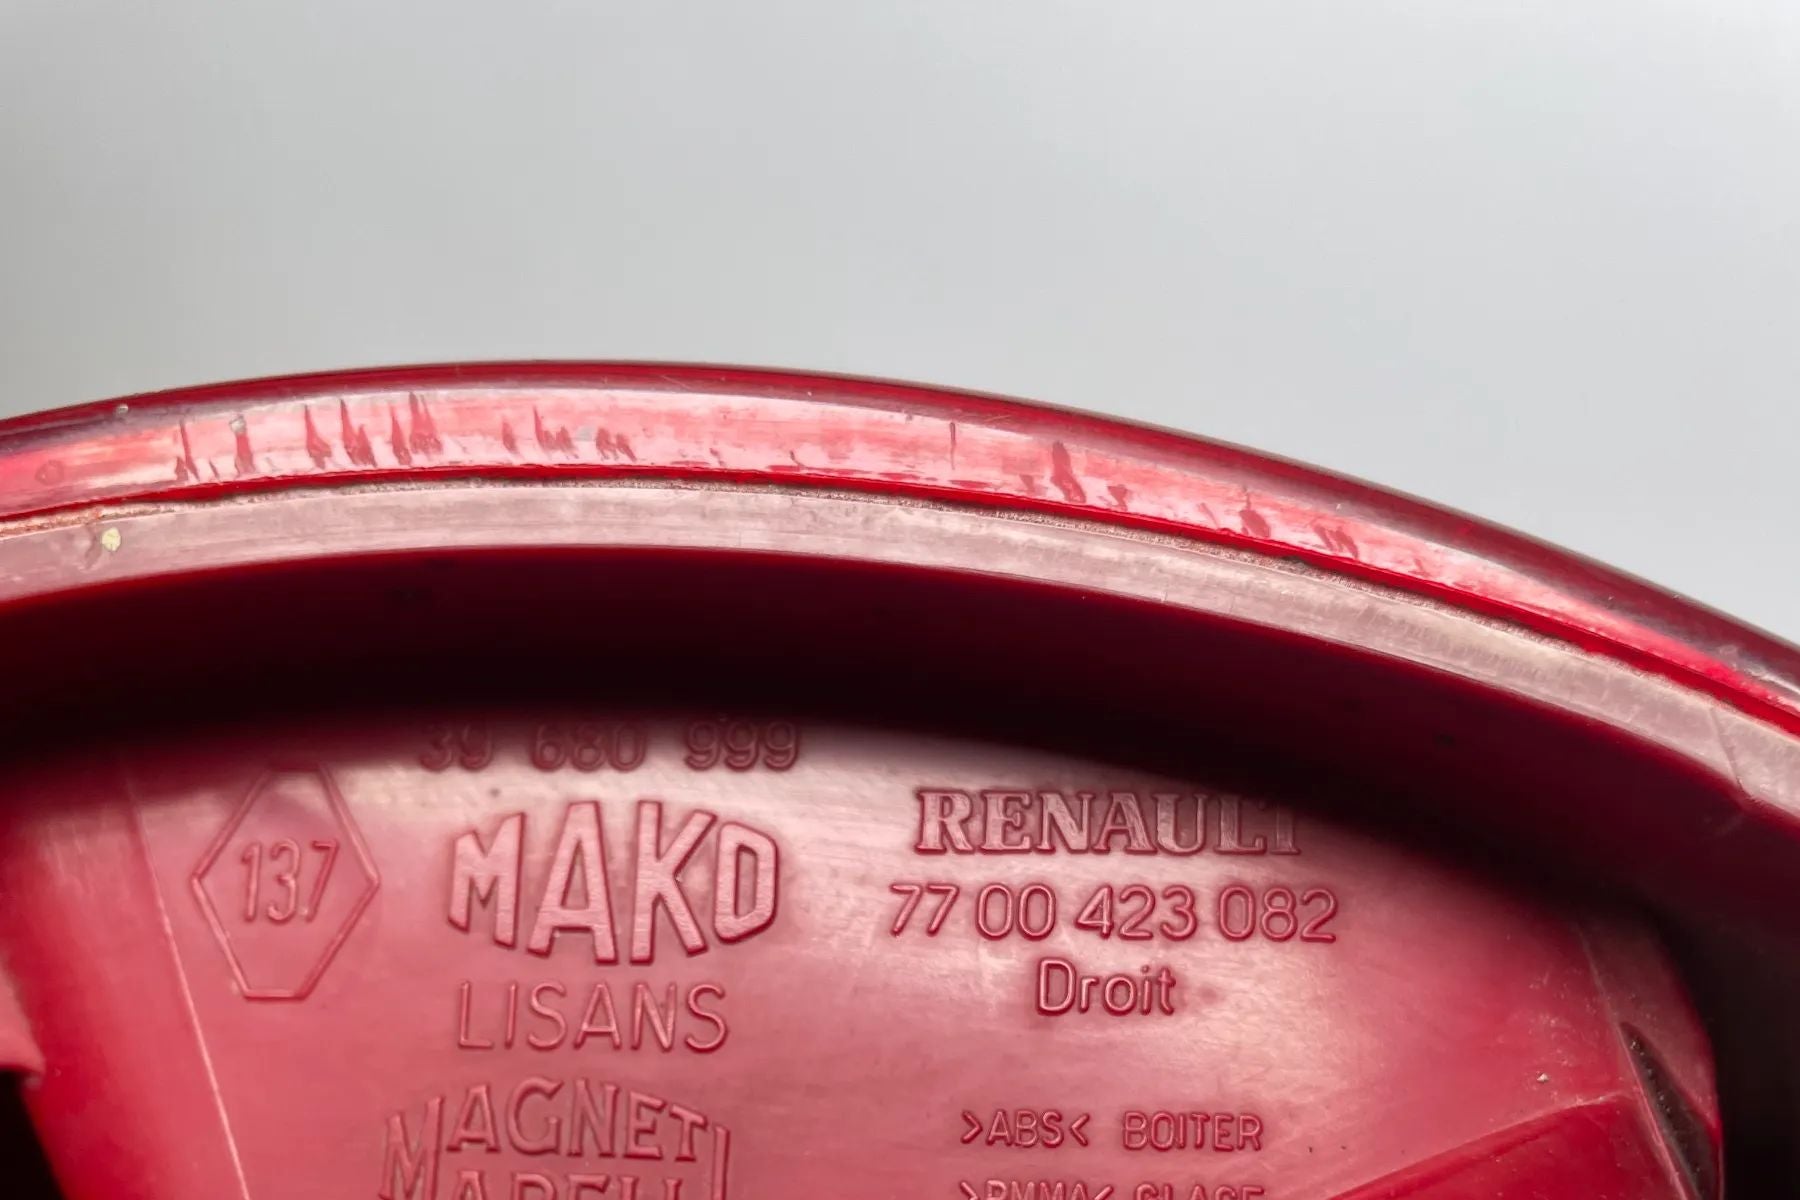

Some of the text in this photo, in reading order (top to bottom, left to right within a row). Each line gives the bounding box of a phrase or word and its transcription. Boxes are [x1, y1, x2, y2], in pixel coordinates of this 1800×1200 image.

[419, 718, 799, 772] 39 680 999
[241, 838, 340, 922] 137
[447, 799, 779, 966] MAKO
[890, 883, 1337, 942] 77 00 423 082
[1037, 958, 1176, 1015] Droit
[458, 981, 729, 1053] LISANS
[1124, 1113, 1263, 1152] BOITER
